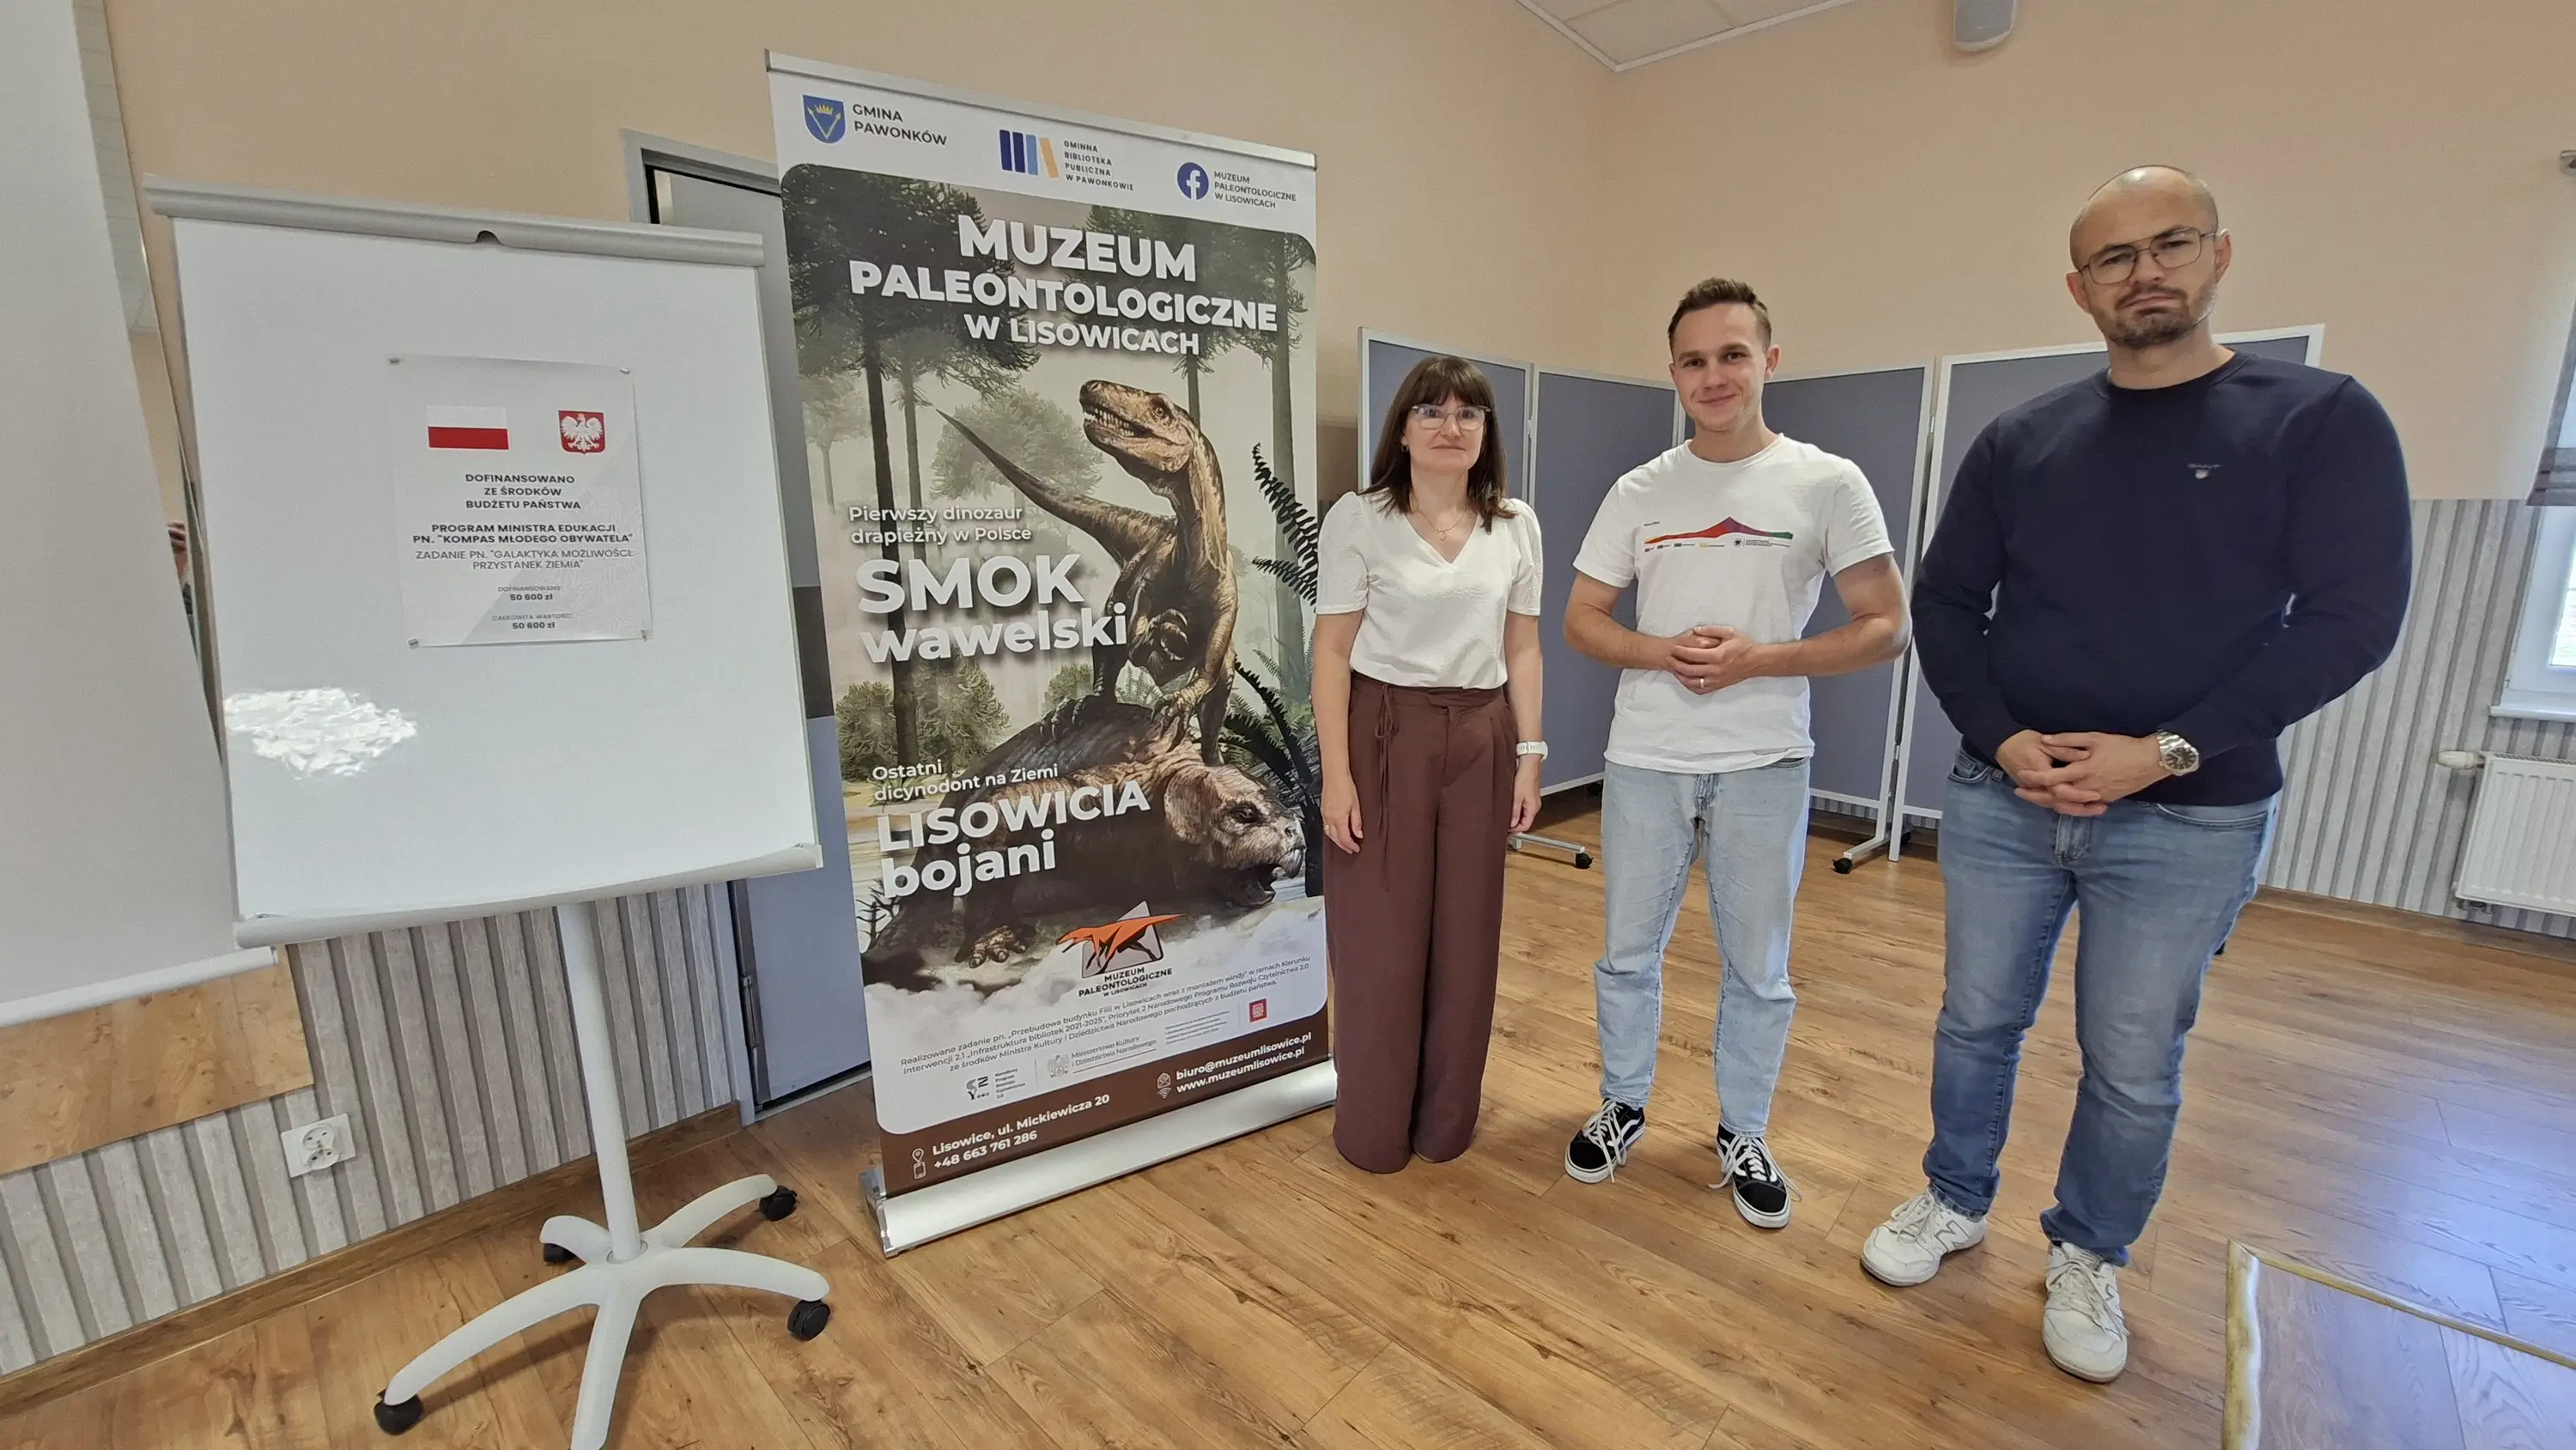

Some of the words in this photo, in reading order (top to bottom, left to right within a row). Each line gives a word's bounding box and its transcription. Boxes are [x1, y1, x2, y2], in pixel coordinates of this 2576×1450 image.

[853, 104, 903, 123] GMINA
[854, 120, 947, 146] PAWONKÓW
[1064, 140, 1098, 153] GMINNA
[1064, 151, 1112, 166] BIBLIOTEKA
[1065, 162, 1111, 176] PUBLICZNA
[1076, 175, 1133, 191] PAWONKOWIE
[1213, 171, 1250, 184] MUZEUM
[1214, 182, 1297, 202] PALEONTOLOGICZNE
[1225, 194, 1276, 209] LISOWICACH
[957, 214, 1197, 282] MUZEUM
[849, 259, 1279, 332] PALEONTOLOGICZNE
[964, 313, 1002, 340] W
[1010, 319, 1200, 355] LISOWICACH
[465, 474, 574, 483] DOFINANSOWANO
[501, 486, 562, 496] ŚRODKÓW
[465, 499, 519, 508] BUDŻETU
[523, 499, 581, 509] PAŃSTWA
[848, 505, 938, 525] Pierwszy
[943, 504, 1023, 521] dinozaur
[413, 535, 435, 543] PN.
[498, 535, 557, 543] MŁODEGO
[558, 524, 616, 532] EDUKACJI
[851, 527, 948, 546] drapieżny
[952, 531, 969, 542] w
[975, 526, 1031, 542] Polsce
[416, 550, 466, 559] ZADANIE
[470, 550, 488, 559] PN.
[473, 561, 542, 569] PRZYSTANEK
[856, 553, 1084, 614] SMOK
[859, 602, 1127, 664] wawelski
[872, 759, 942, 781] Ostatni
[874, 775, 981, 802] dicynodont
[985, 773, 1006, 787] na
[1011, 763, 1059, 784] Ziemi
[877, 780, 1151, 852] LISOWICIA
[881, 828, 1056, 899] bojani
[1078, 968, 1173, 997] PALEONTOLOGICZNE
[1104, 967, 1145, 982] MUZEUM
[1111, 982, 1148, 996] LISOWICACH
[901, 1047, 956, 1066] Realizowane
[958, 1037, 991, 1052] zadanie
[993, 1034, 1006, 1046] pn.
[1063, 1010, 1097, 1024] budynku
[1099, 1006, 1113, 1016] Filii
[1122, 993, 1161, 1008] Lisowicach
[1163, 989, 1180, 998] wraz
[1187, 978, 1224, 992] montażem
[1256, 962, 1280, 974] ramach
[1282, 956, 1310, 968] Kierunku
[955, 1052, 965, 1063] 2.1
[1030, 1027, 1064, 1041] bibliotek
[1109, 1007, 1140, 1021] Priorytet
[1148, 994, 1193, 1010] Narodowego
[1194, 986, 1228, 998] Programu
[1230, 977, 1256, 990] Rozwoju
[1258, 967, 1298, 981] Czytelnictwa
[1299, 962, 1309, 971] 2.0
[961, 1054, 998, 1068] środków
[999, 1045, 1031, 1059] Ministra
[1034, 1037, 1063, 1049] Kultury
[1069, 1023, 1115, 1040] Dziedzictwa
[1116, 1010, 1162, 1027] Narodowego
[1163, 996, 1213, 1016] pochodzących
[1220, 987, 1247, 1000] budżetu
[1071, 1043, 1115, 1059] Ministerstwo
[1116, 1035, 1140, 1047] Kultury
[1075, 1052, 1115, 1066] Dziedzictwa
[1116, 1039, 1157, 1055] Narodowego
[1176, 1031, 1312, 1080] biuro@muzeumlisowice.pl
[1176, 1046, 1304, 1093] www.muzeumlisowice.pl
[933, 1131, 994, 1156] Lisowice,
[998, 1124, 1013, 1135] ul.
[1017, 1101, 1092, 1131] Mickiewicza
[1095, 1094, 1110, 1106] 20
[934, 1154, 960, 1168] +48
[963, 1147, 987, 1161] 663
[990, 1138, 1011, 1153] 761
[1014, 1130, 1037, 1145] 286
